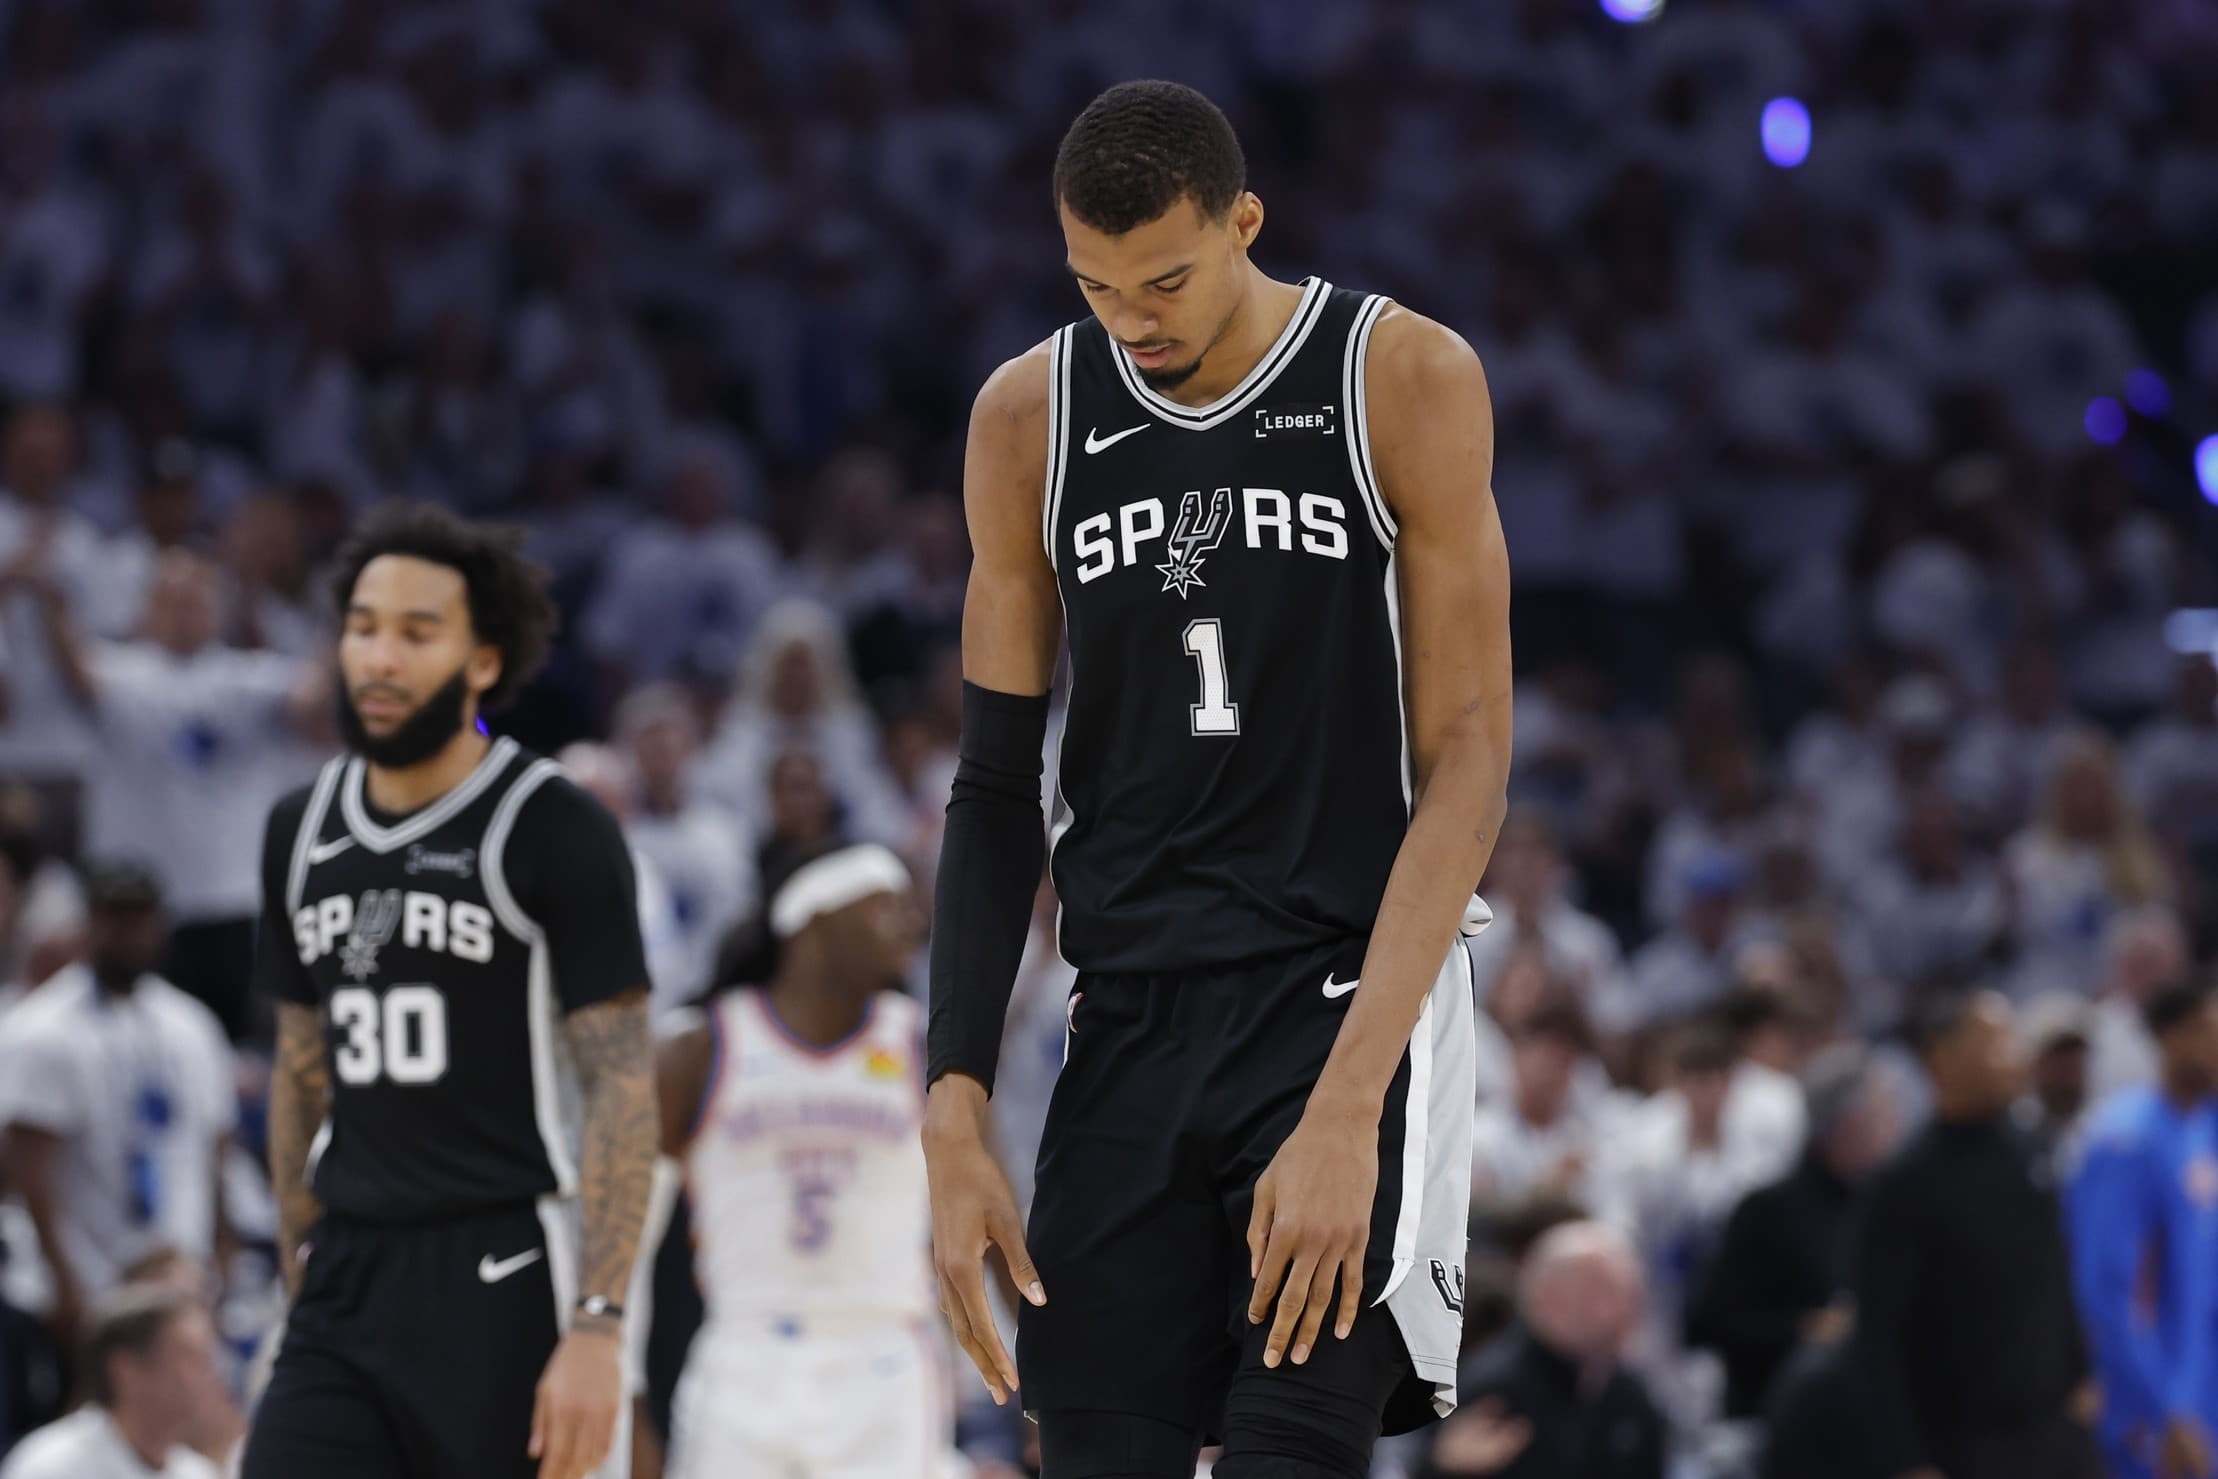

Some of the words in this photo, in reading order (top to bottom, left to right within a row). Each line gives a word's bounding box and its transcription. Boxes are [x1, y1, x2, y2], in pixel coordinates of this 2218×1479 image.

[1264, 414, 1325, 430] LEDGER
[1073, 487, 1349, 600] SPURS
[1182, 617, 1241, 736] 1
[329, 983, 449, 1085] 30
